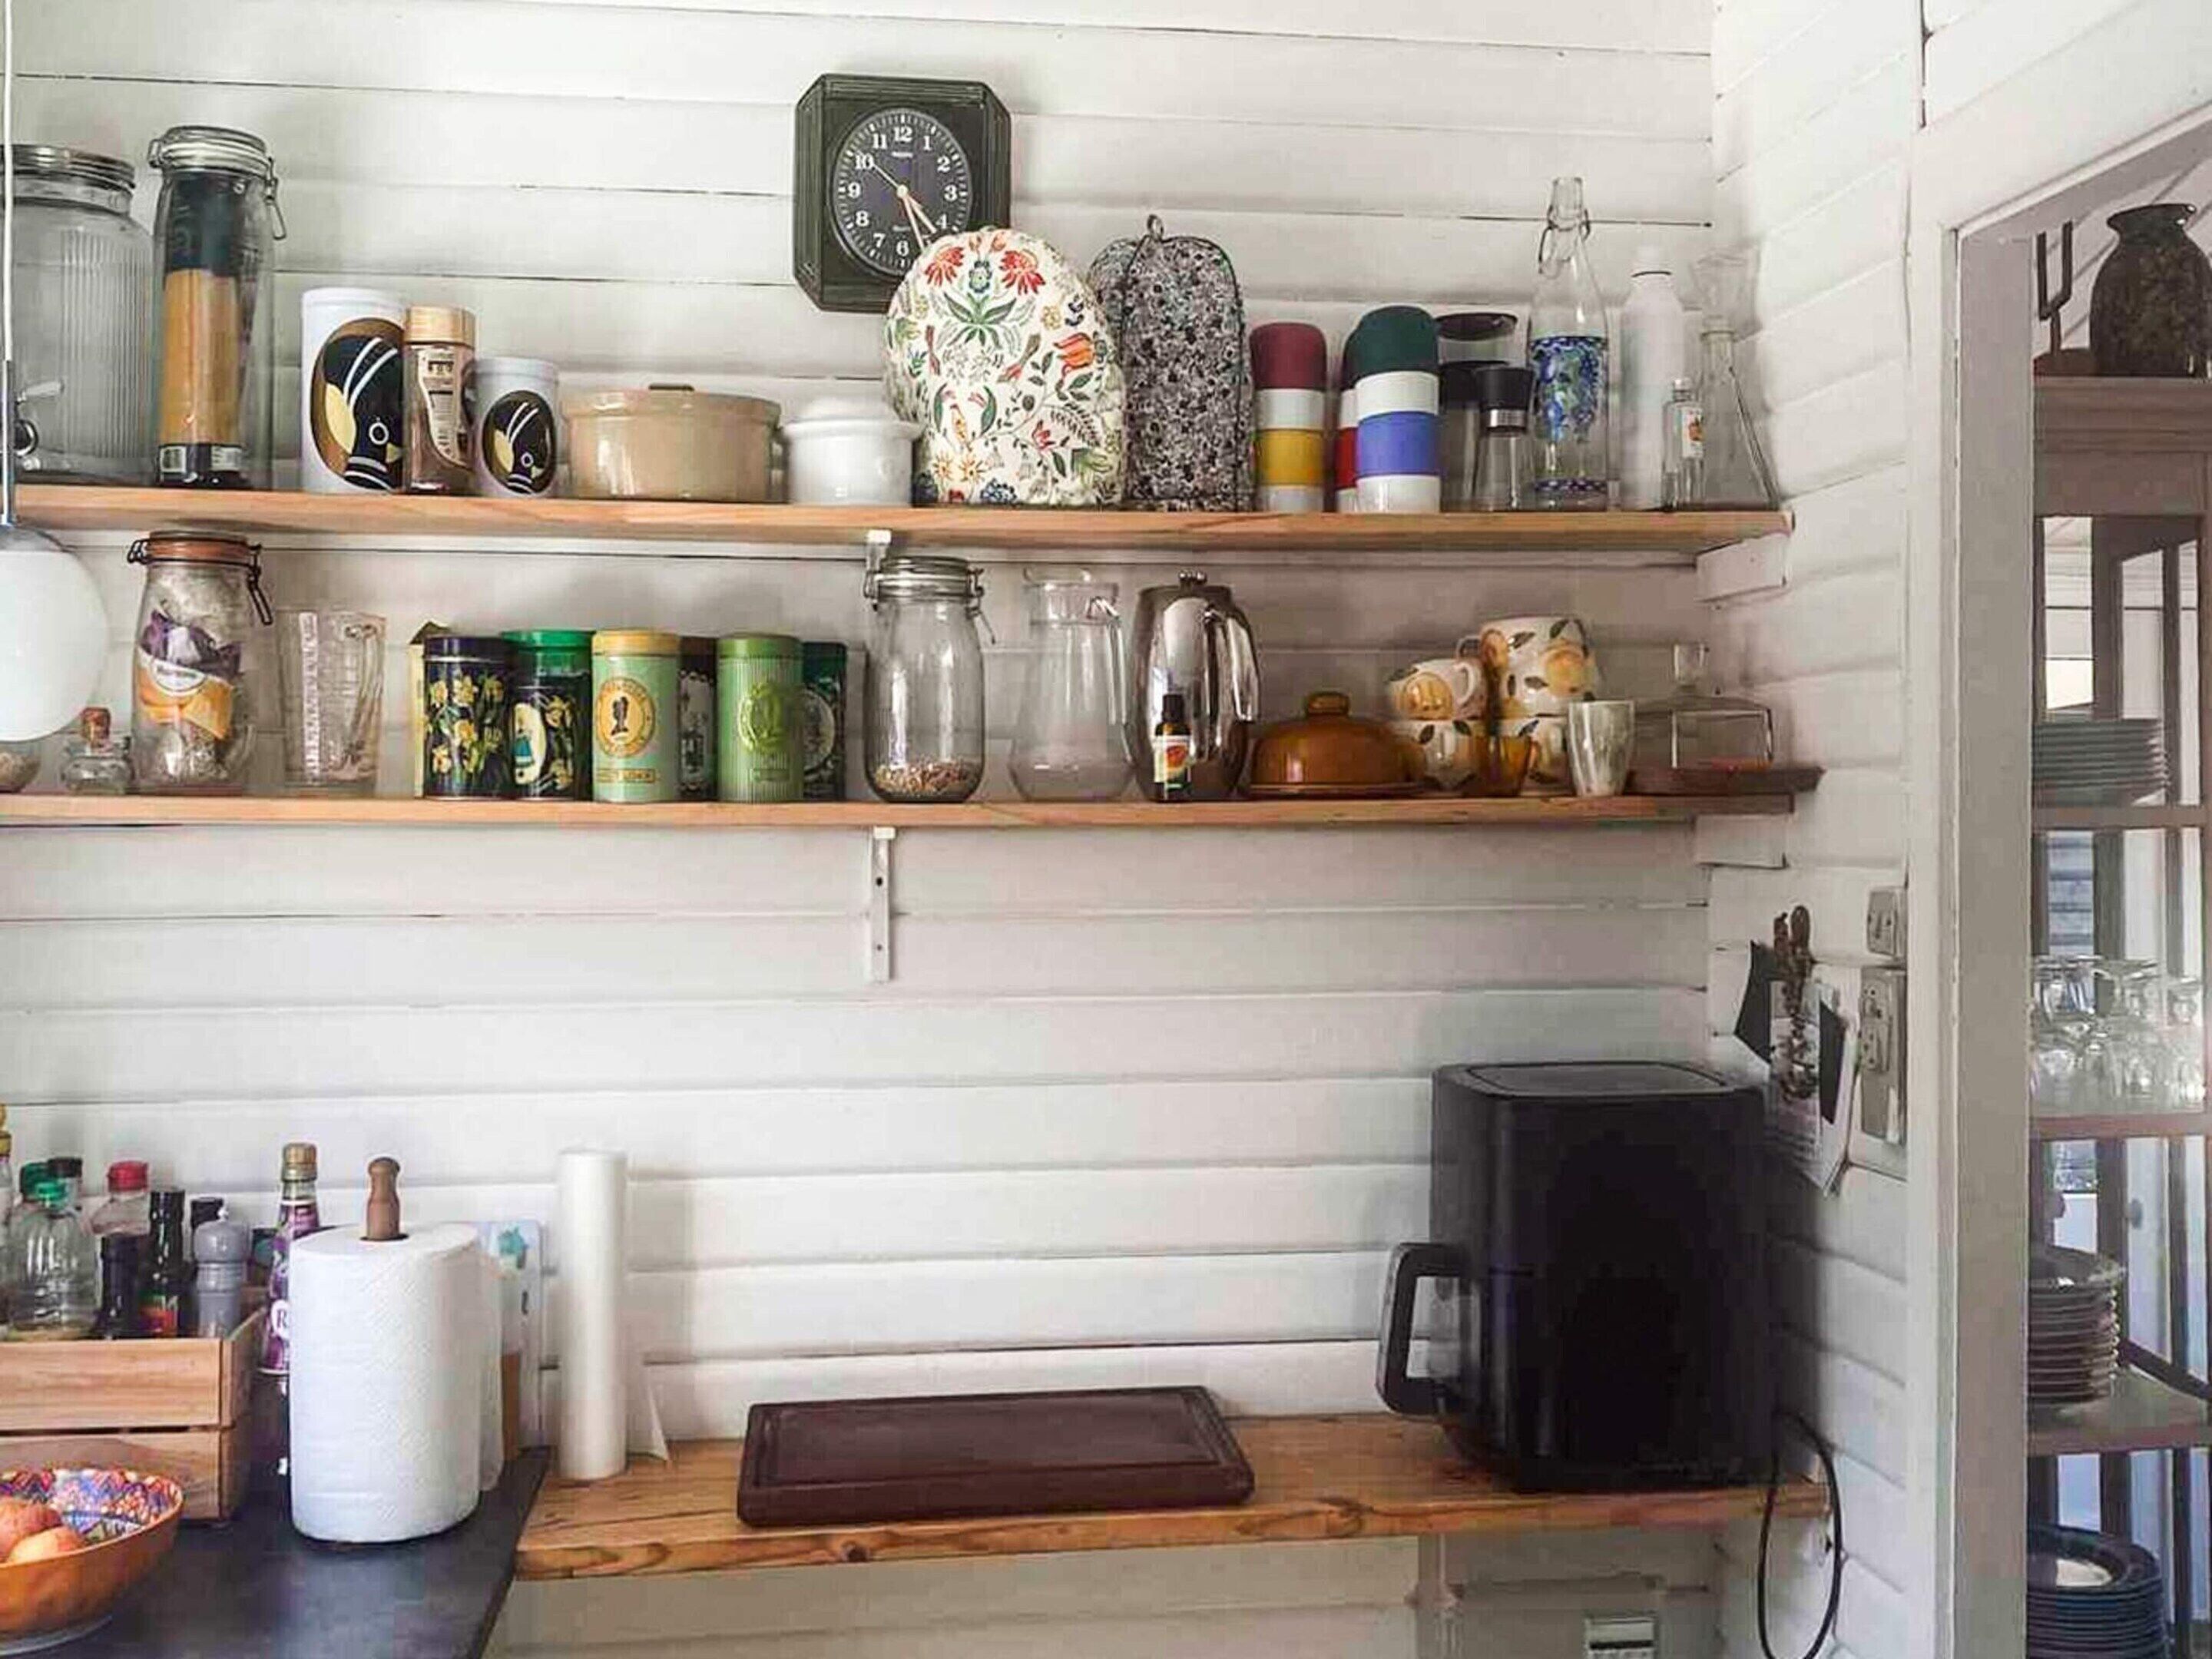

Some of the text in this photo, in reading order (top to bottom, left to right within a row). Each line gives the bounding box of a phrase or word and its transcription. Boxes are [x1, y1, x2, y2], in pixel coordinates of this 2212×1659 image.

[873, 134, 888, 149] 11
[893, 126, 912, 142] 12
[923, 136, 932, 151] 1
[854, 155, 873, 170] 10
[937, 157, 950, 171] 2
[848, 183, 861, 198] 9
[945, 185, 957, 200] 3
[856, 211, 869, 227] 8
[935, 215, 949, 229] 4
[873, 233, 885, 247] 7
[896, 241, 909, 256] 6
